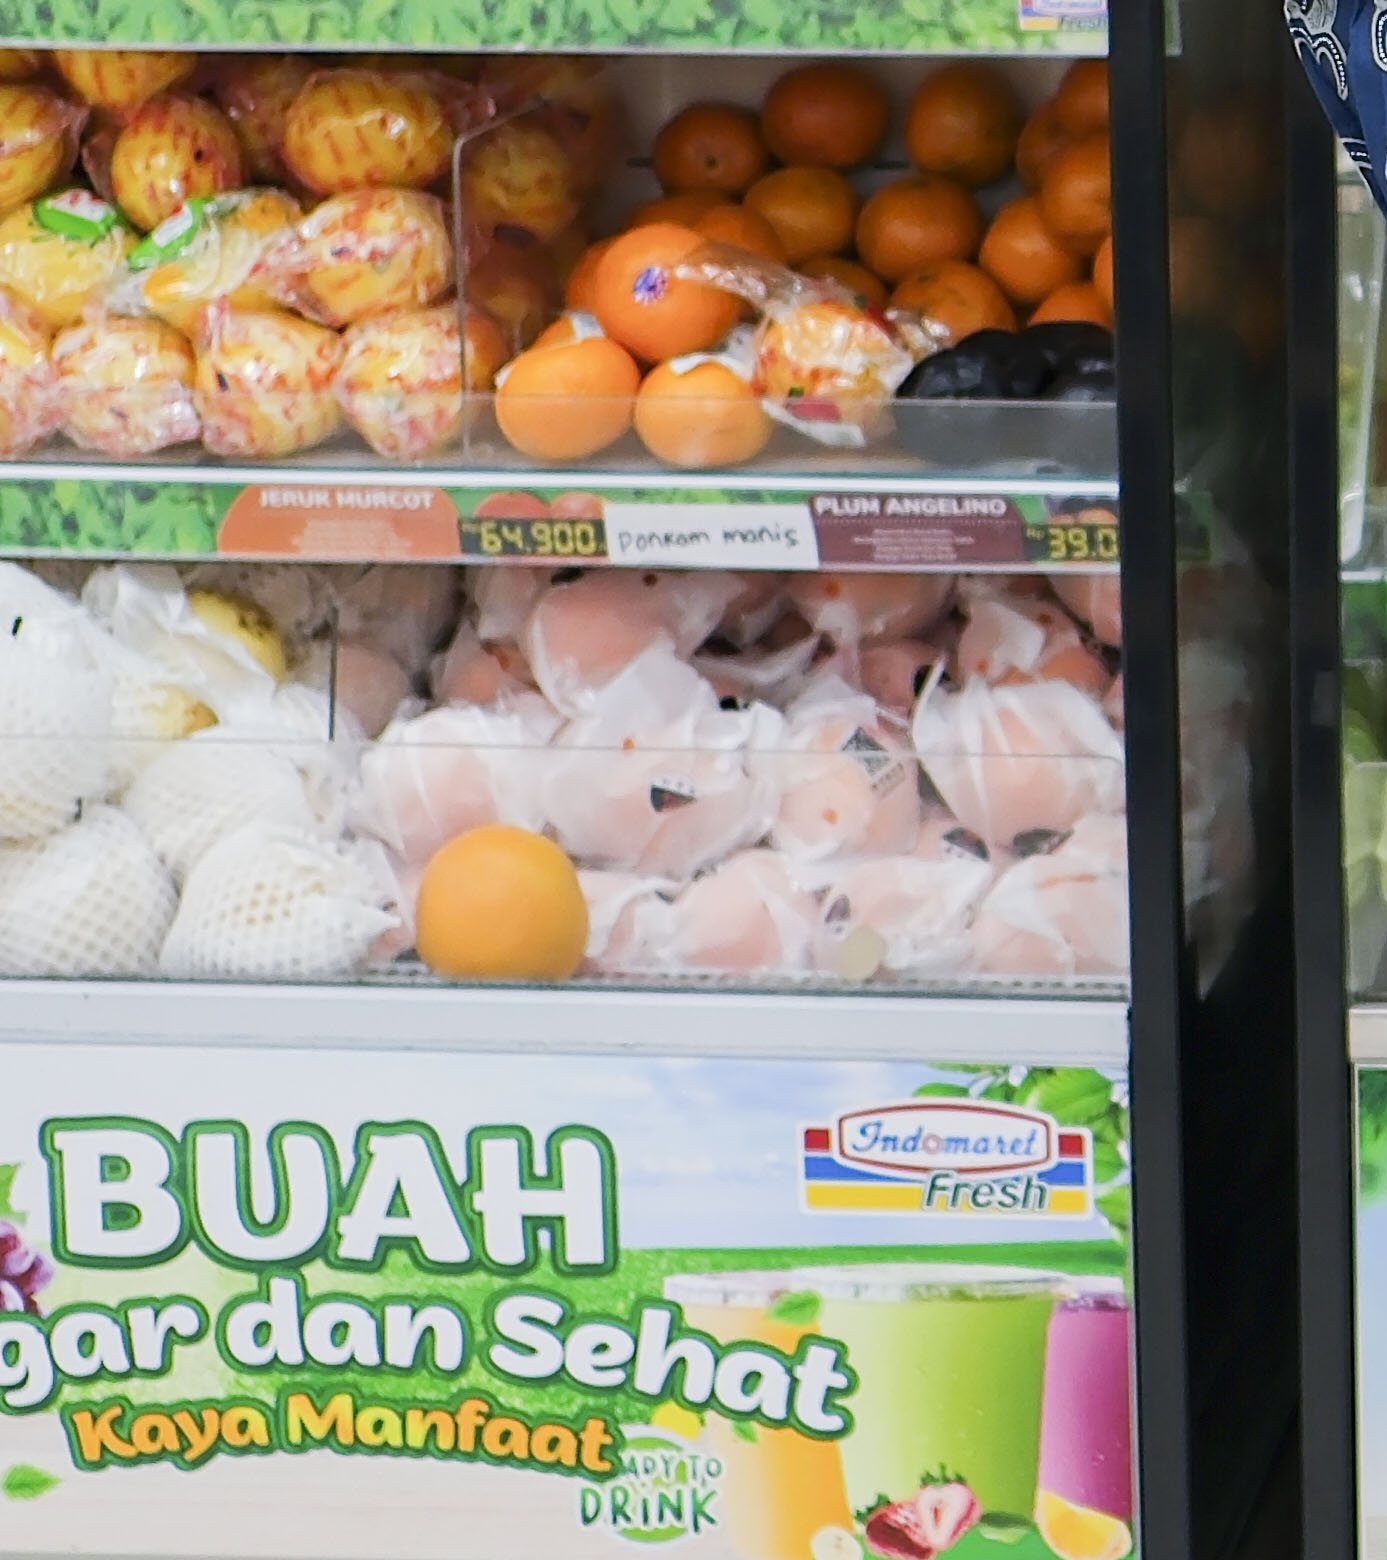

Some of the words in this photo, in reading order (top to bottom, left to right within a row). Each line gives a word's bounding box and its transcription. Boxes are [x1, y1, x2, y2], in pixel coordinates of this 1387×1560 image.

[813, 496, 880, 517] PLUM
[883, 496, 1008, 518] ANGELINO
[480, 521, 596, 555] 64.900
[1049, 527, 1119, 560] 39.0
[852, 1120, 1038, 1157] Indomaret
[50, 1126, 608, 1269] BUAH
[924, 1171, 1047, 1209] Fresh
[223, 1273, 464, 1373] dan
[488, 1292, 849, 1432] Sehat
[73, 1404, 270, 1463] Kaya
[286, 1393, 613, 1472] Manfaat
[624, 1455, 672, 1478] ADY
[687, 1455, 722, 1478] TO
